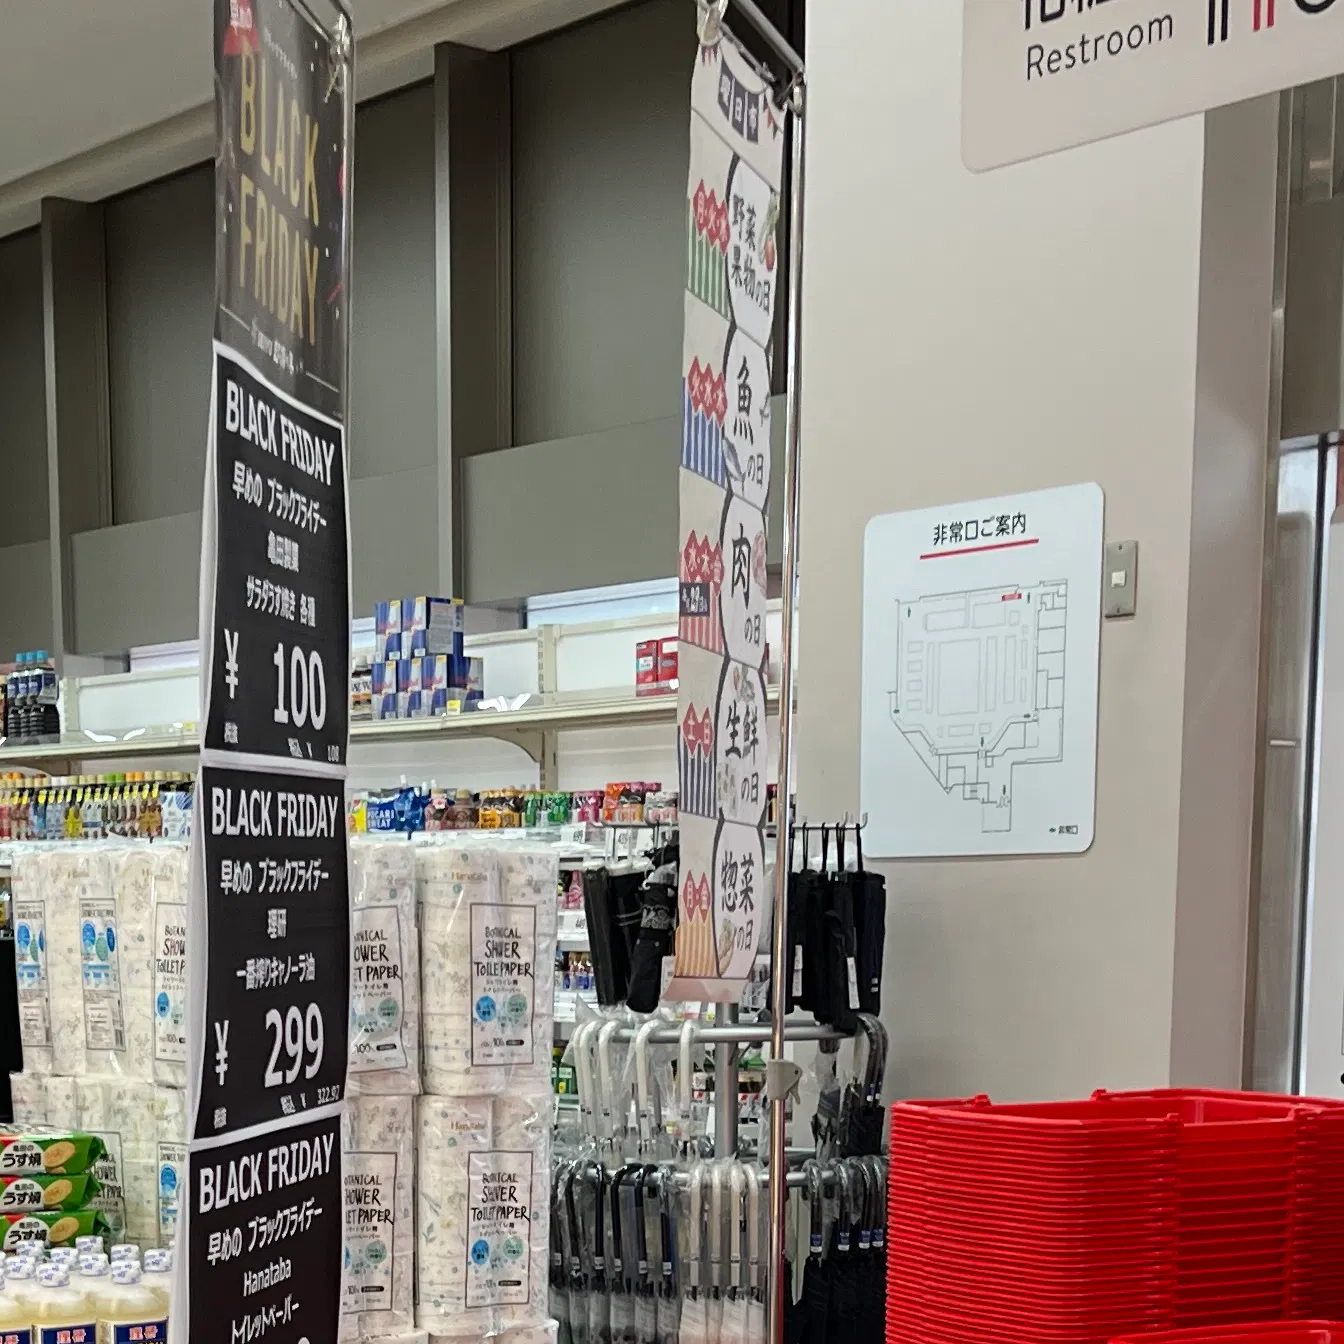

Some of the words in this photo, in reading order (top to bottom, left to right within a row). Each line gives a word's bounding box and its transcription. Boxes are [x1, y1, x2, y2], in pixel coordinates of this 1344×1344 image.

[1026, 14, 1173, 80] Restroom
[240, 42, 319, 228] BLACK
[732, 194, 757, 252] 野菜
[240, 173, 318, 346] FRIDAY
[731, 245, 771, 316] 果物の日
[733, 355, 754, 446] 魚
[225, 379, 278, 457] BLACK
[280, 413, 335, 486] FRIDAY
[232, 460, 263, 507] 早めの
[747, 453, 764, 485] の日
[932, 512, 1027, 546] 非常口ご案内
[731, 522, 752, 609] 肉
[744, 614, 761, 646] の日
[273, 642, 327, 730] 100
[725, 703, 758, 766] 生鮮
[211, 786, 272, 838] BLACK
[277, 792, 339, 838] FRIDAY
[741, 771, 760, 805] の日
[220, 859, 253, 895] 早めの
[258, 857, 329, 893] ブラックフライデー
[721, 851, 755, 915] 惣菜
[736, 919, 753, 951] の日
[366, 965, 403, 981] PAPER
[500, 961, 535, 980] PAPER
[264, 1002, 324, 1088] 299
[2, 1152, 42, 1168] うす焼
[199, 1161, 262, 1214] BLACK
[267, 1133, 335, 1190] FRIDAY
[3, 1190, 42, 1206] うす焼
[357, 1208, 394, 1225] PAPER
[496, 1205, 531, 1221] PAPER
[207, 1227, 243, 1266] 早めの
[248, 1197, 323, 1252] ブラックフライデー
[243, 1256, 292, 1297] Hanataba
